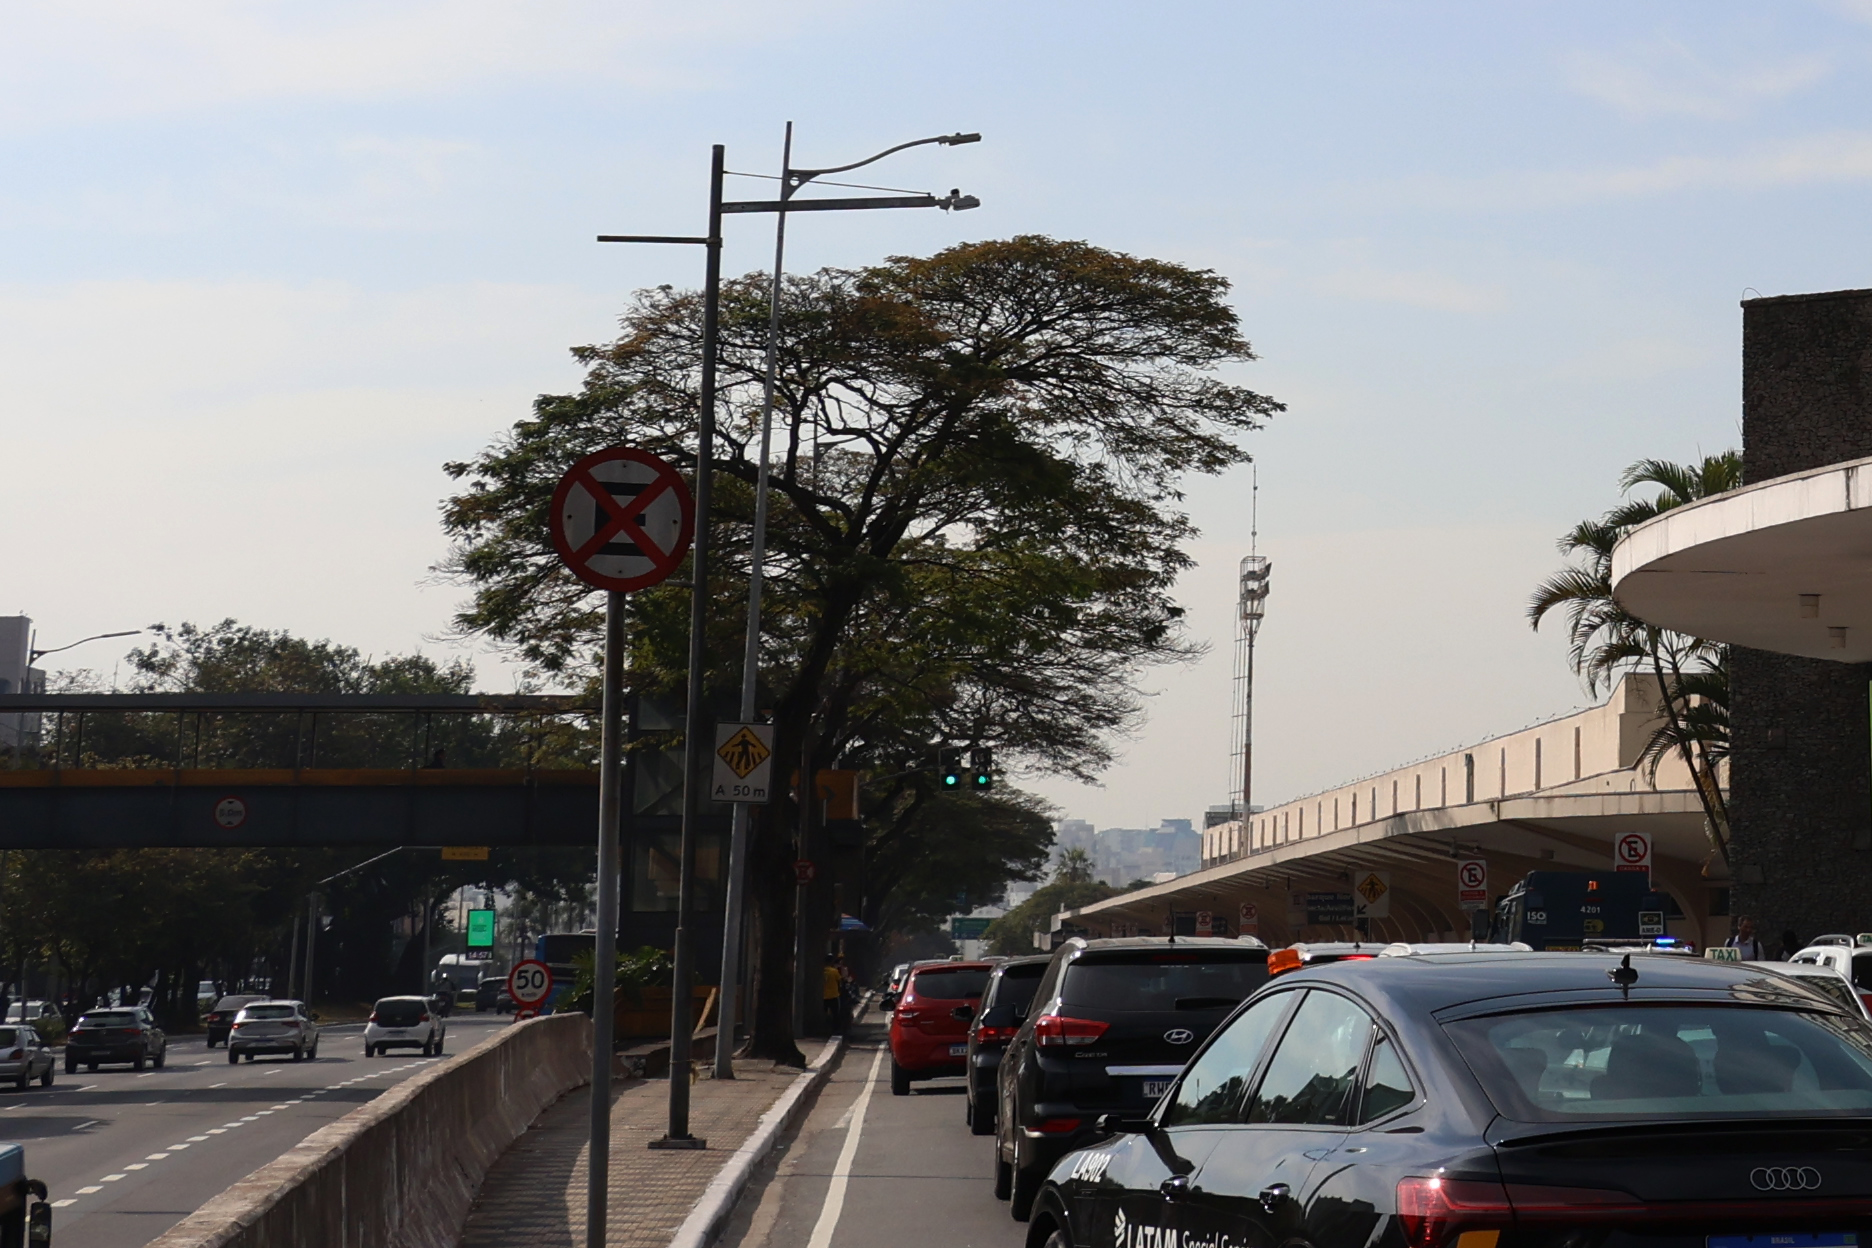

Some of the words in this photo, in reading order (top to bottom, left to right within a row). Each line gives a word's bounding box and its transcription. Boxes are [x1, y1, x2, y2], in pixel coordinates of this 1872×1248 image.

[715, 785, 725, 796] A
[733, 785, 751, 797] 50
[753, 788, 766, 797] m
[1580, 906, 1601, 914] 4201
[1527, 912, 1547, 921] ISO
[1710, 949, 1738, 962] TAXI
[517, 969, 545, 990] 50
[1071, 1151, 1111, 1183] LA902
